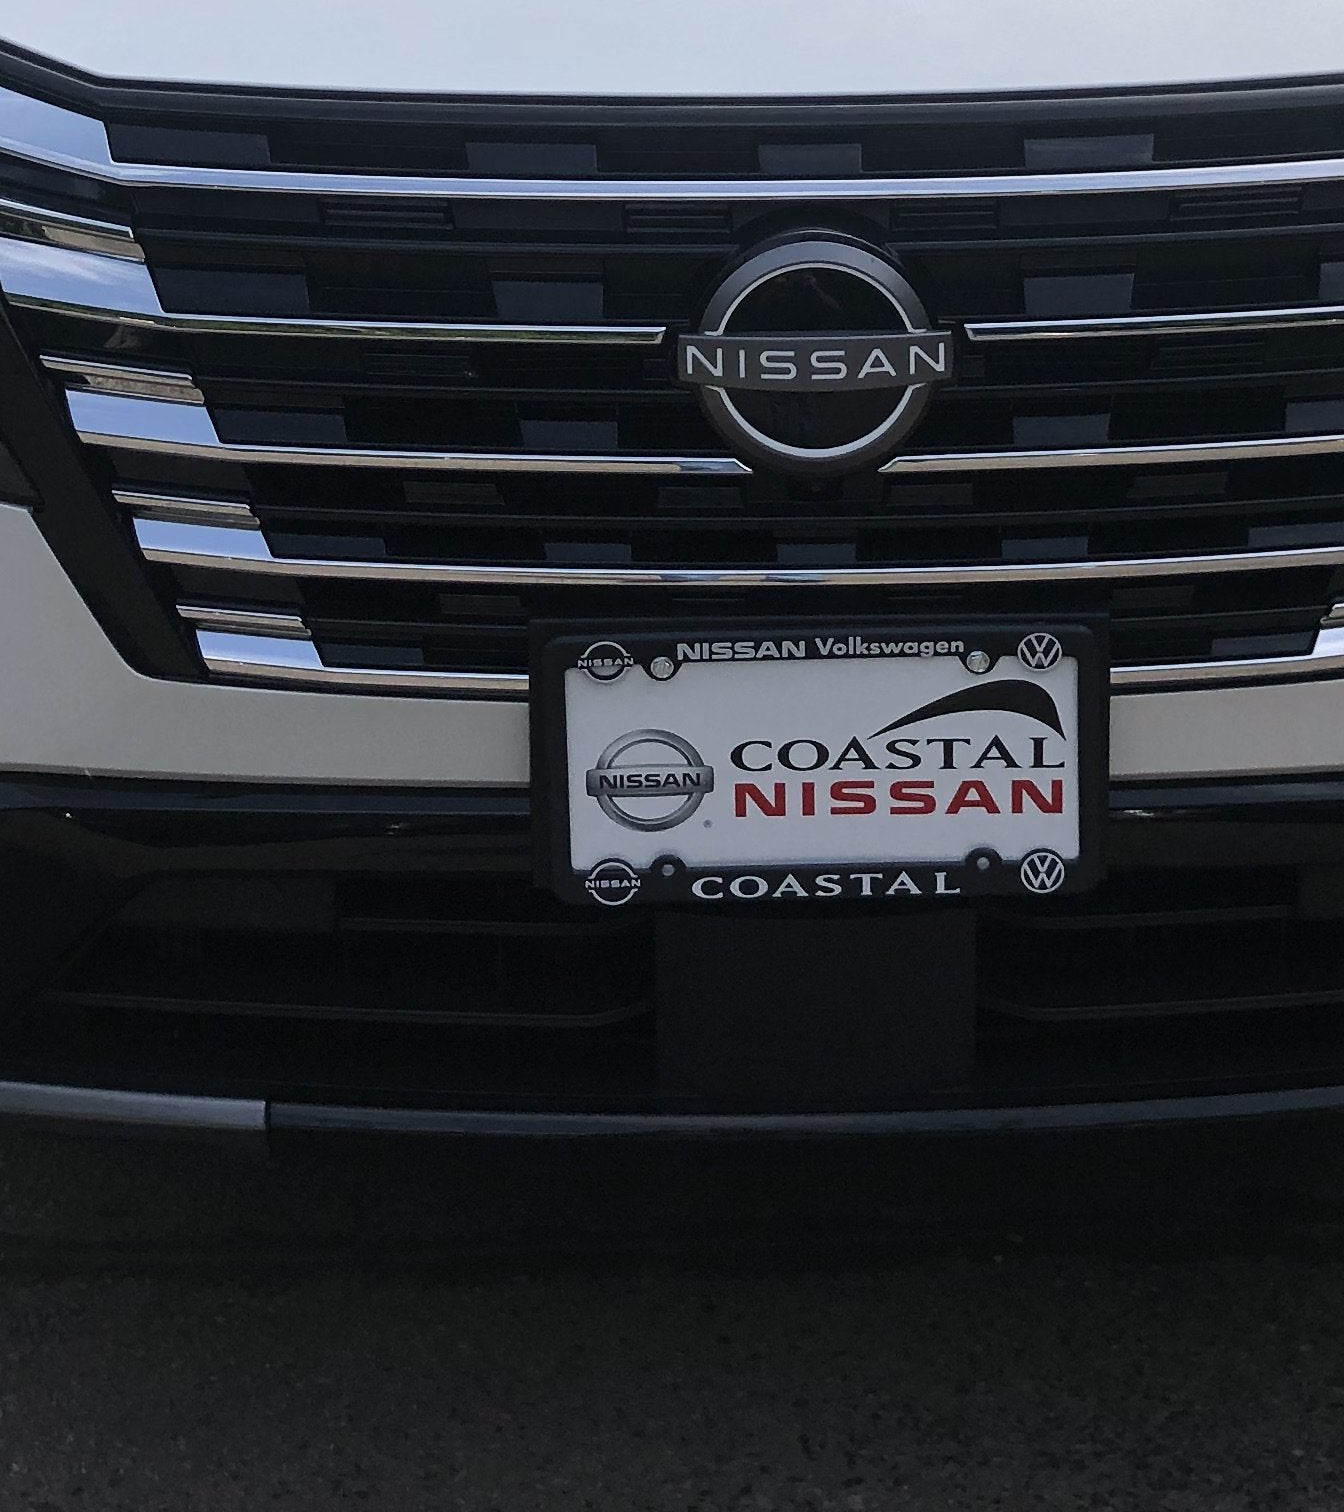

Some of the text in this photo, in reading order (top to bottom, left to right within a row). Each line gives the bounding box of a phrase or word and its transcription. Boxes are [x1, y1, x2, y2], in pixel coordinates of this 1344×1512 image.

[686, 342, 946, 380] NISSAN
[676, 637, 965, 661] NISSAN Volkswagen
[577, 657, 634, 668] NISSAN
[730, 735, 1066, 772] COASTAL
[599, 772, 701, 789] NISSAN
[734, 778, 1064, 818] NISSAN
[585, 878, 641, 889] NISSAN
[691, 871, 961, 900] COASTAL
